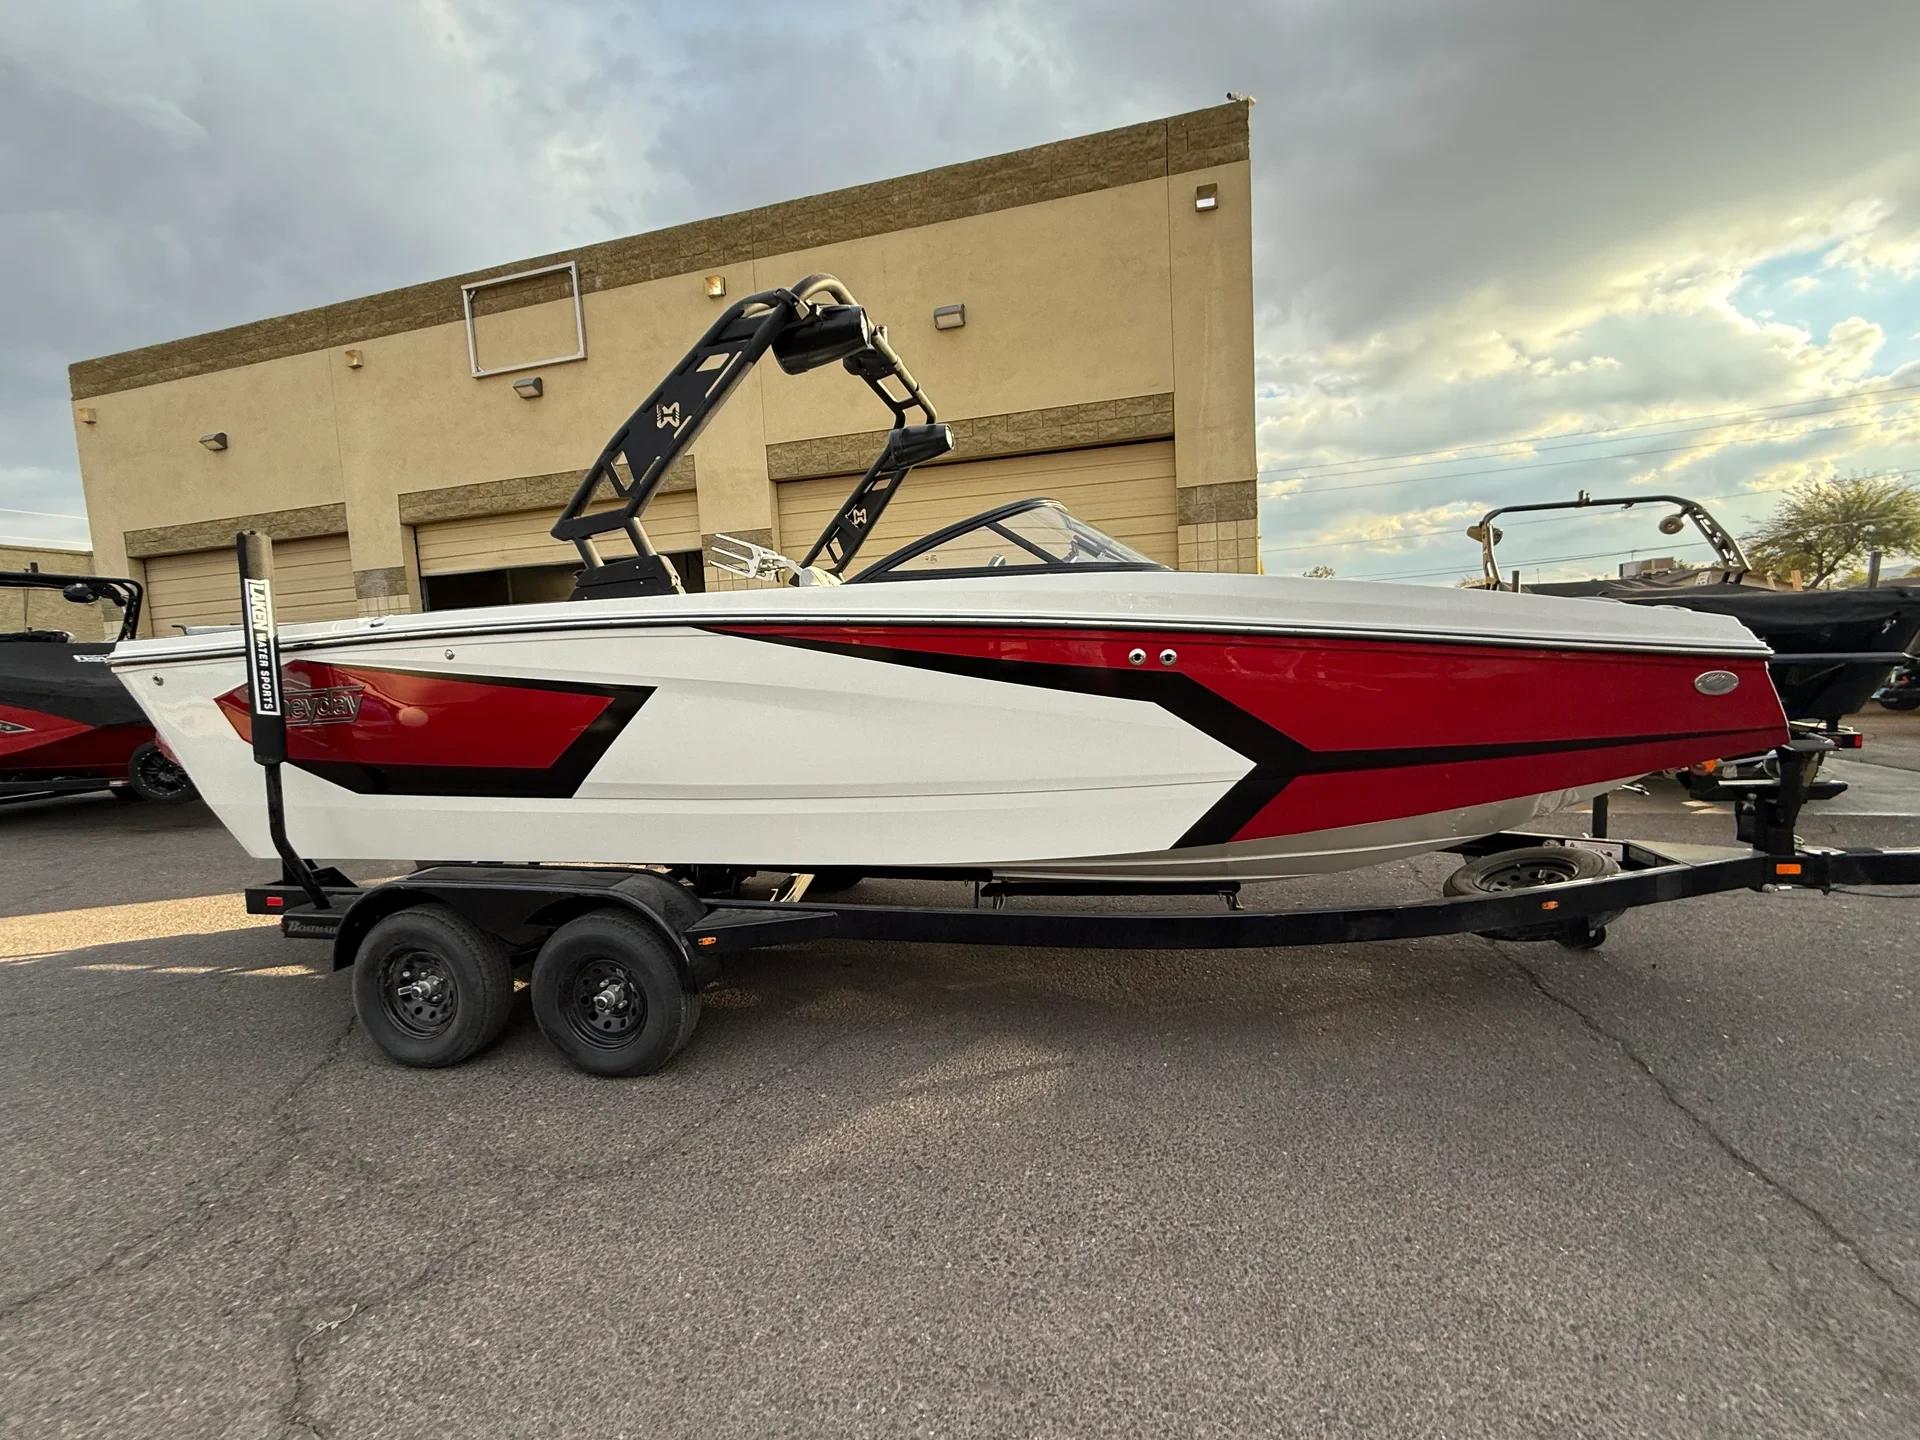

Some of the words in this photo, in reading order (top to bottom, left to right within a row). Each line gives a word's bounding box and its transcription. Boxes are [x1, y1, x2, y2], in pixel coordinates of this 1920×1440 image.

[249, 583, 268, 631] LAKEN
[256, 632, 269, 667] WATER
[260, 670, 274, 710] SPORTS
